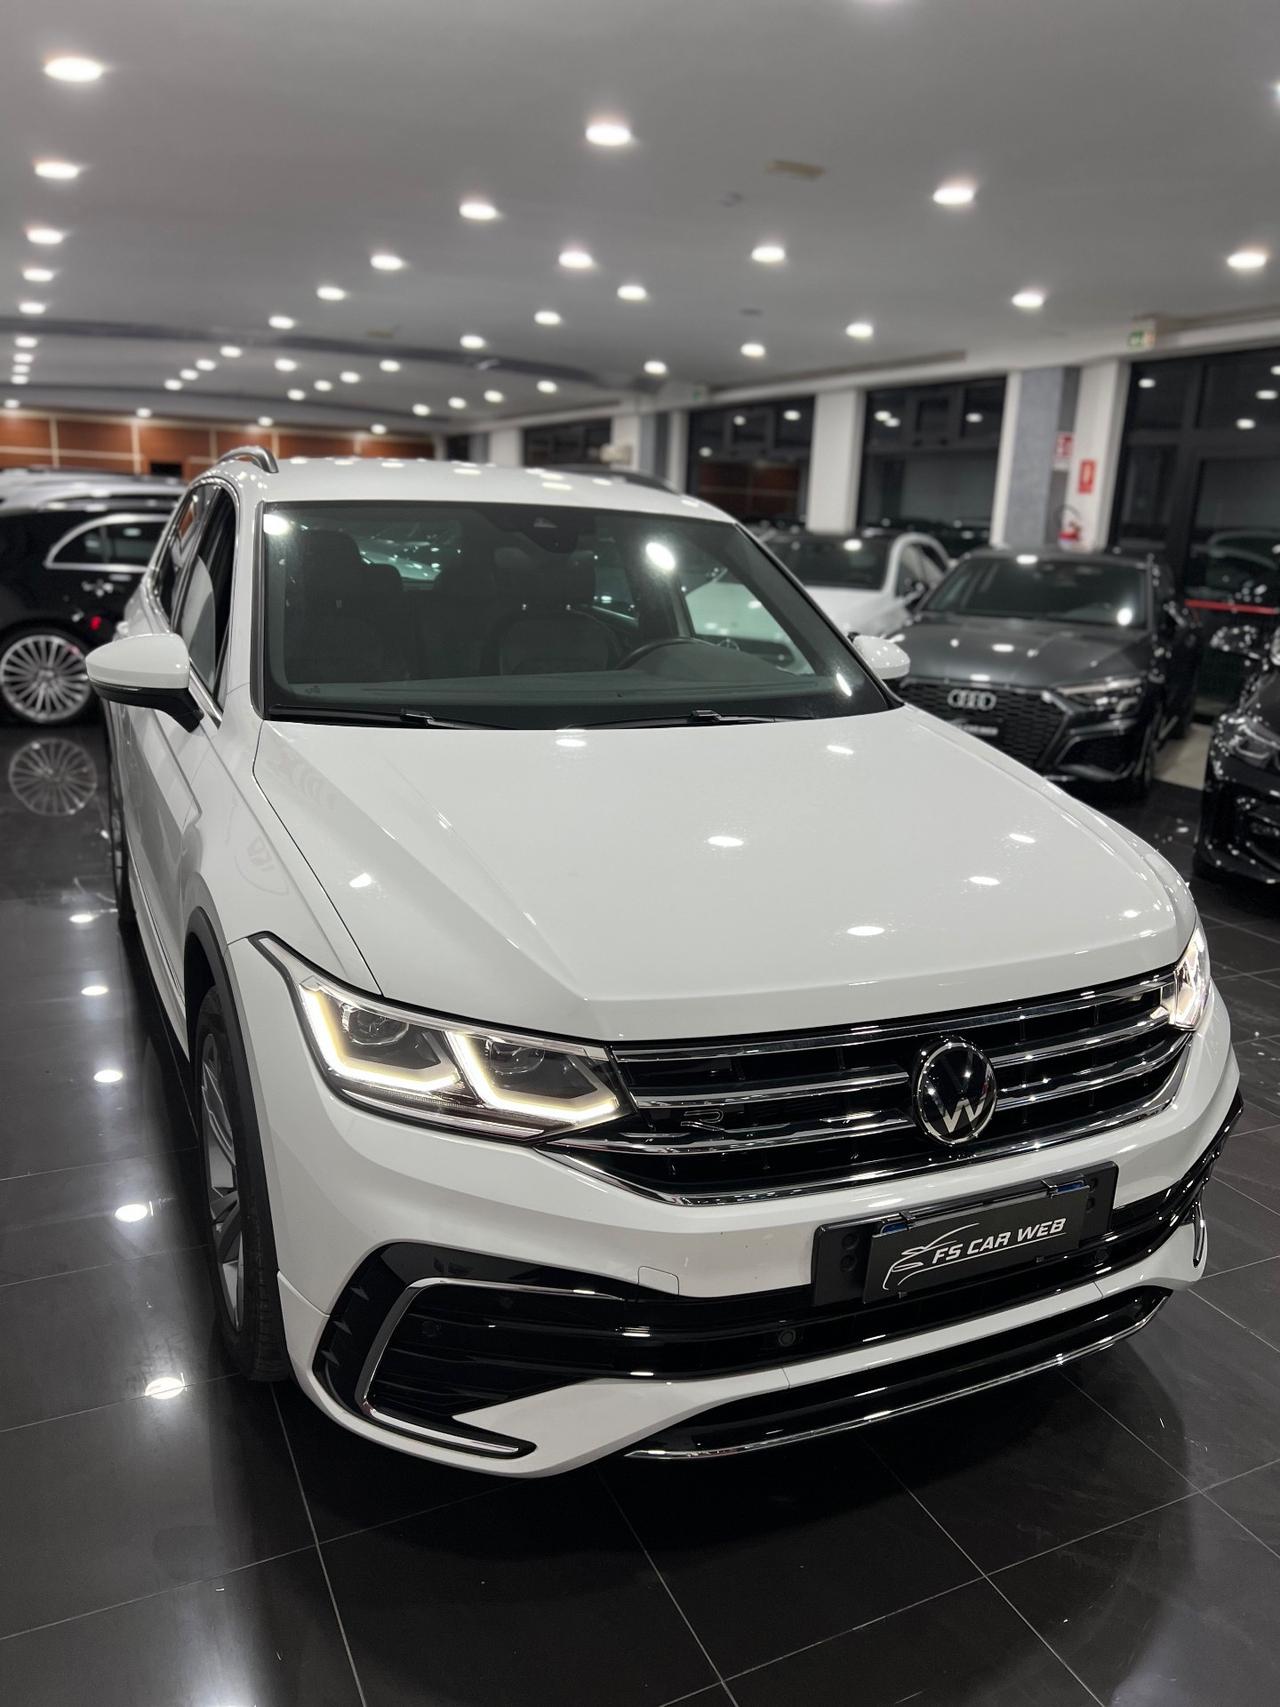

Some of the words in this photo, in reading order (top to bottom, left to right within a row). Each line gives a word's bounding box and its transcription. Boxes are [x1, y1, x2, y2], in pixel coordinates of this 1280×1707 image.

[932, 1244, 963, 1264] FS
[967, 1231, 1012, 1255] CAR
[1017, 1217, 1067, 1242] WEB
